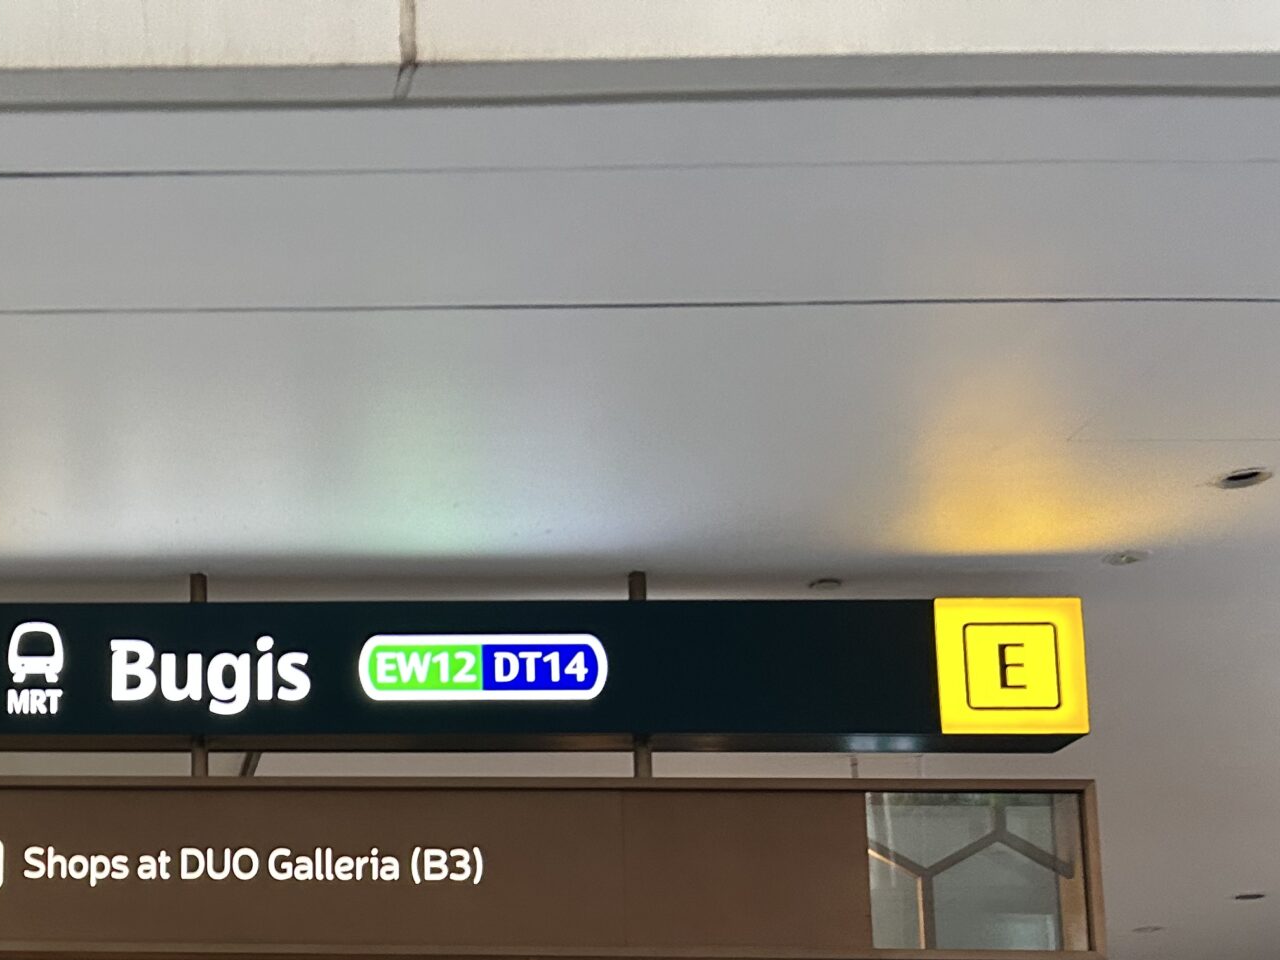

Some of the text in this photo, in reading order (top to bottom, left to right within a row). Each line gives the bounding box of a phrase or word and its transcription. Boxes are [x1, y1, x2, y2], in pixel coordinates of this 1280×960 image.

[110, 635, 589, 715] Bugis EW12 DT14
[997, 642, 1028, 690] E
[6, 688, 64, 715] MRT
[23, 846, 484, 888] Shops at DUO Galleria (B3)
